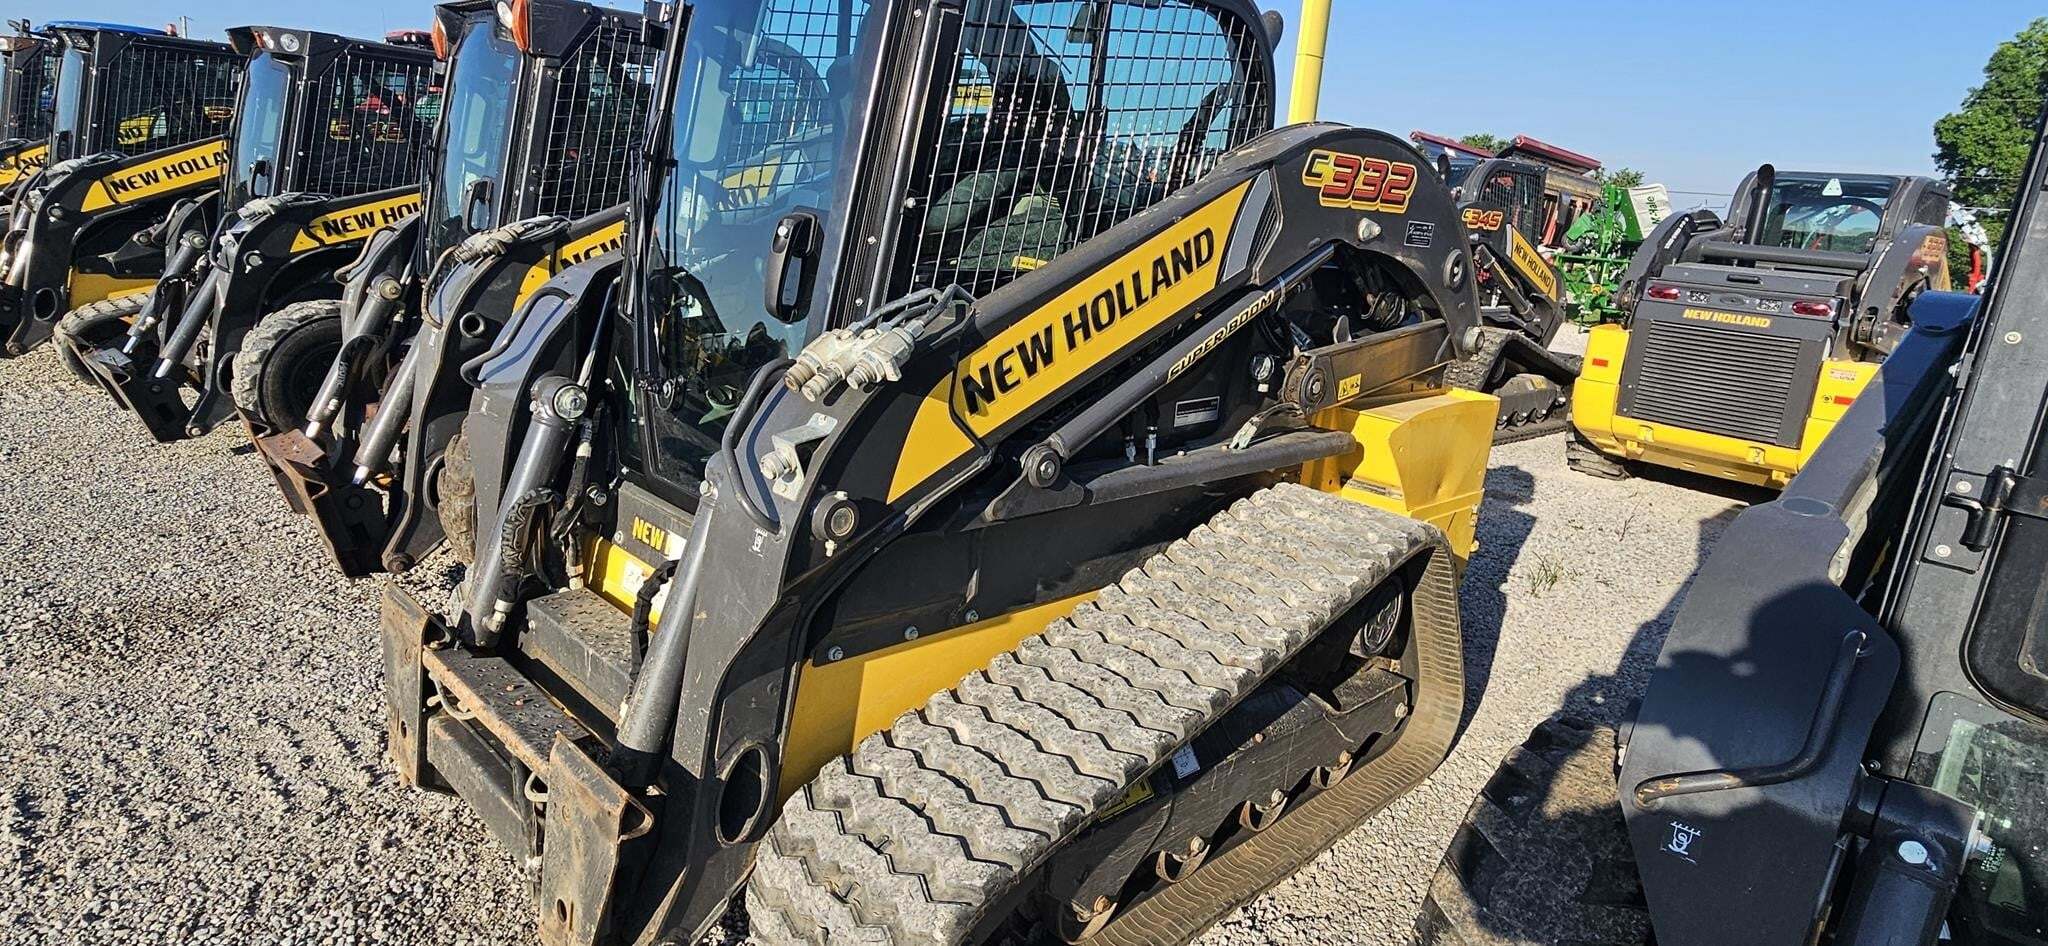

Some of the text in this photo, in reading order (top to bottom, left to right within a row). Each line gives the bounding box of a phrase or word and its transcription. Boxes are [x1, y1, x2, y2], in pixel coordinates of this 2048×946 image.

[20, 152, 48, 177] NE
[110, 150, 231, 195] NEW HOLLA
[1302, 149, 1418, 214] C332
[322, 211, 376, 238] NEW
[1514, 242, 1551, 288] NEW HOLLAND
[961, 226, 1215, 415] NEW HOLLAND
[1167, 289, 1275, 384] SUPER BOOM
[1683, 308, 1771, 328] NEW HOLLAND
[632, 515, 666, 551] NEW
